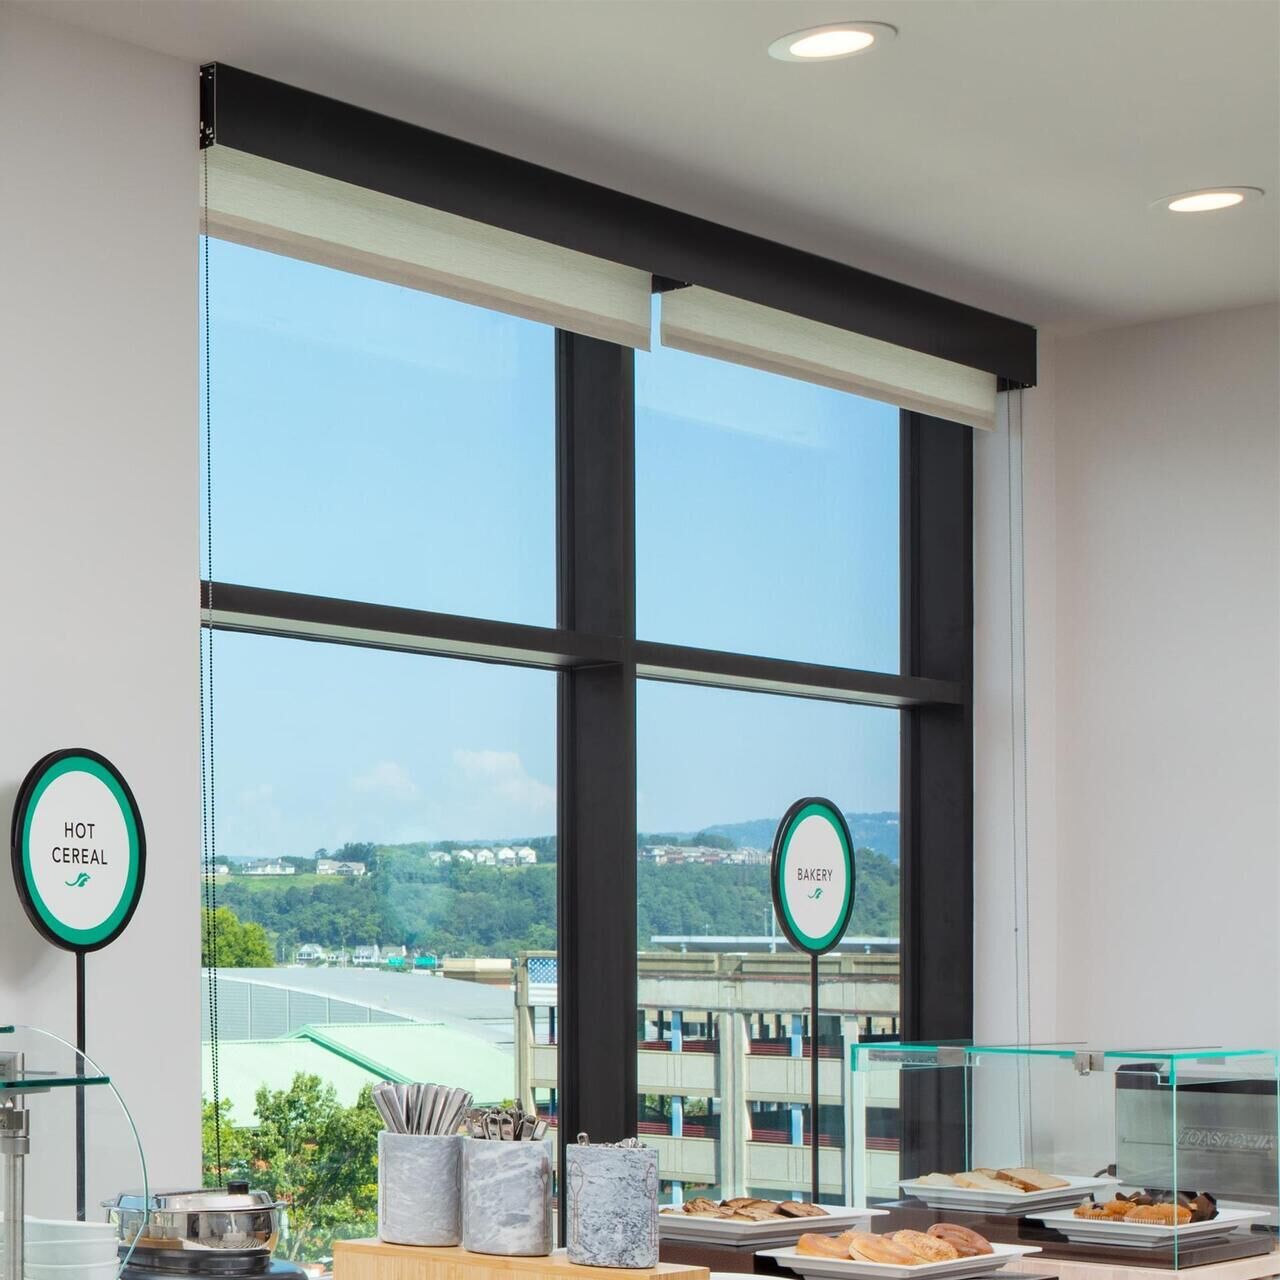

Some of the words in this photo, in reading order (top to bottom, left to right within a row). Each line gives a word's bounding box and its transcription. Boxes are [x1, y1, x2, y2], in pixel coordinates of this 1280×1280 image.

[64, 821, 96, 839] HOT
[51, 846, 108, 865] CEREAL
[797, 868, 833, 882] BAKERY
